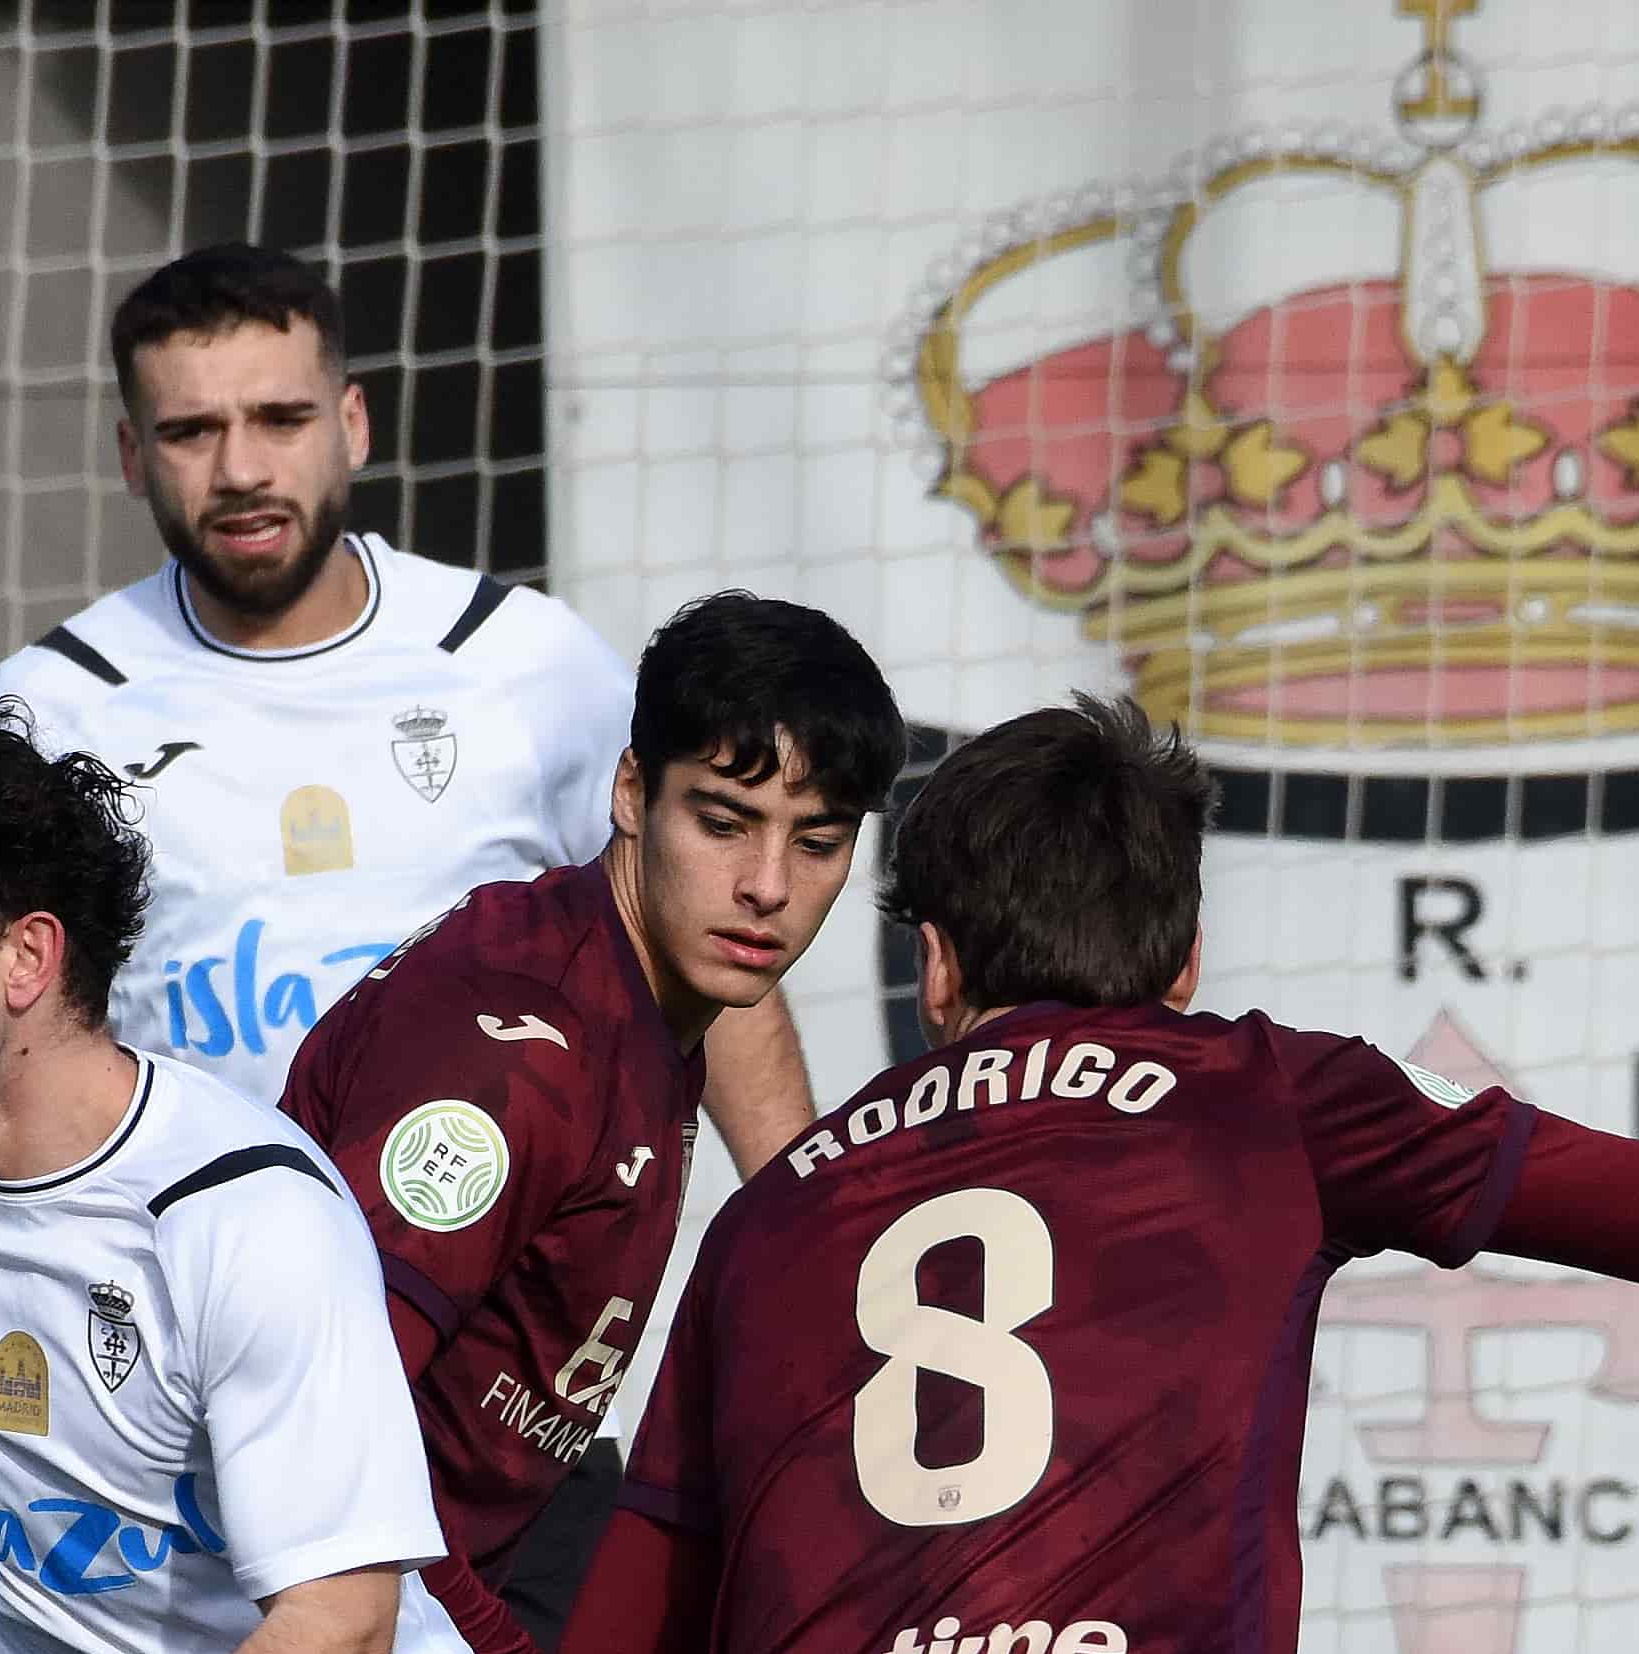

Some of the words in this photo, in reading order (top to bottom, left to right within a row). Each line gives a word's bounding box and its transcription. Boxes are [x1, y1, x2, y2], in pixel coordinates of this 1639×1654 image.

[164, 918, 401, 1059] isla
[1397, 872, 1529, 984] R.
[786, 1037, 1178, 1179] RODRIGO
[479, 1371, 595, 1466] FINANH
[853, 1187, 1054, 1527] 8
